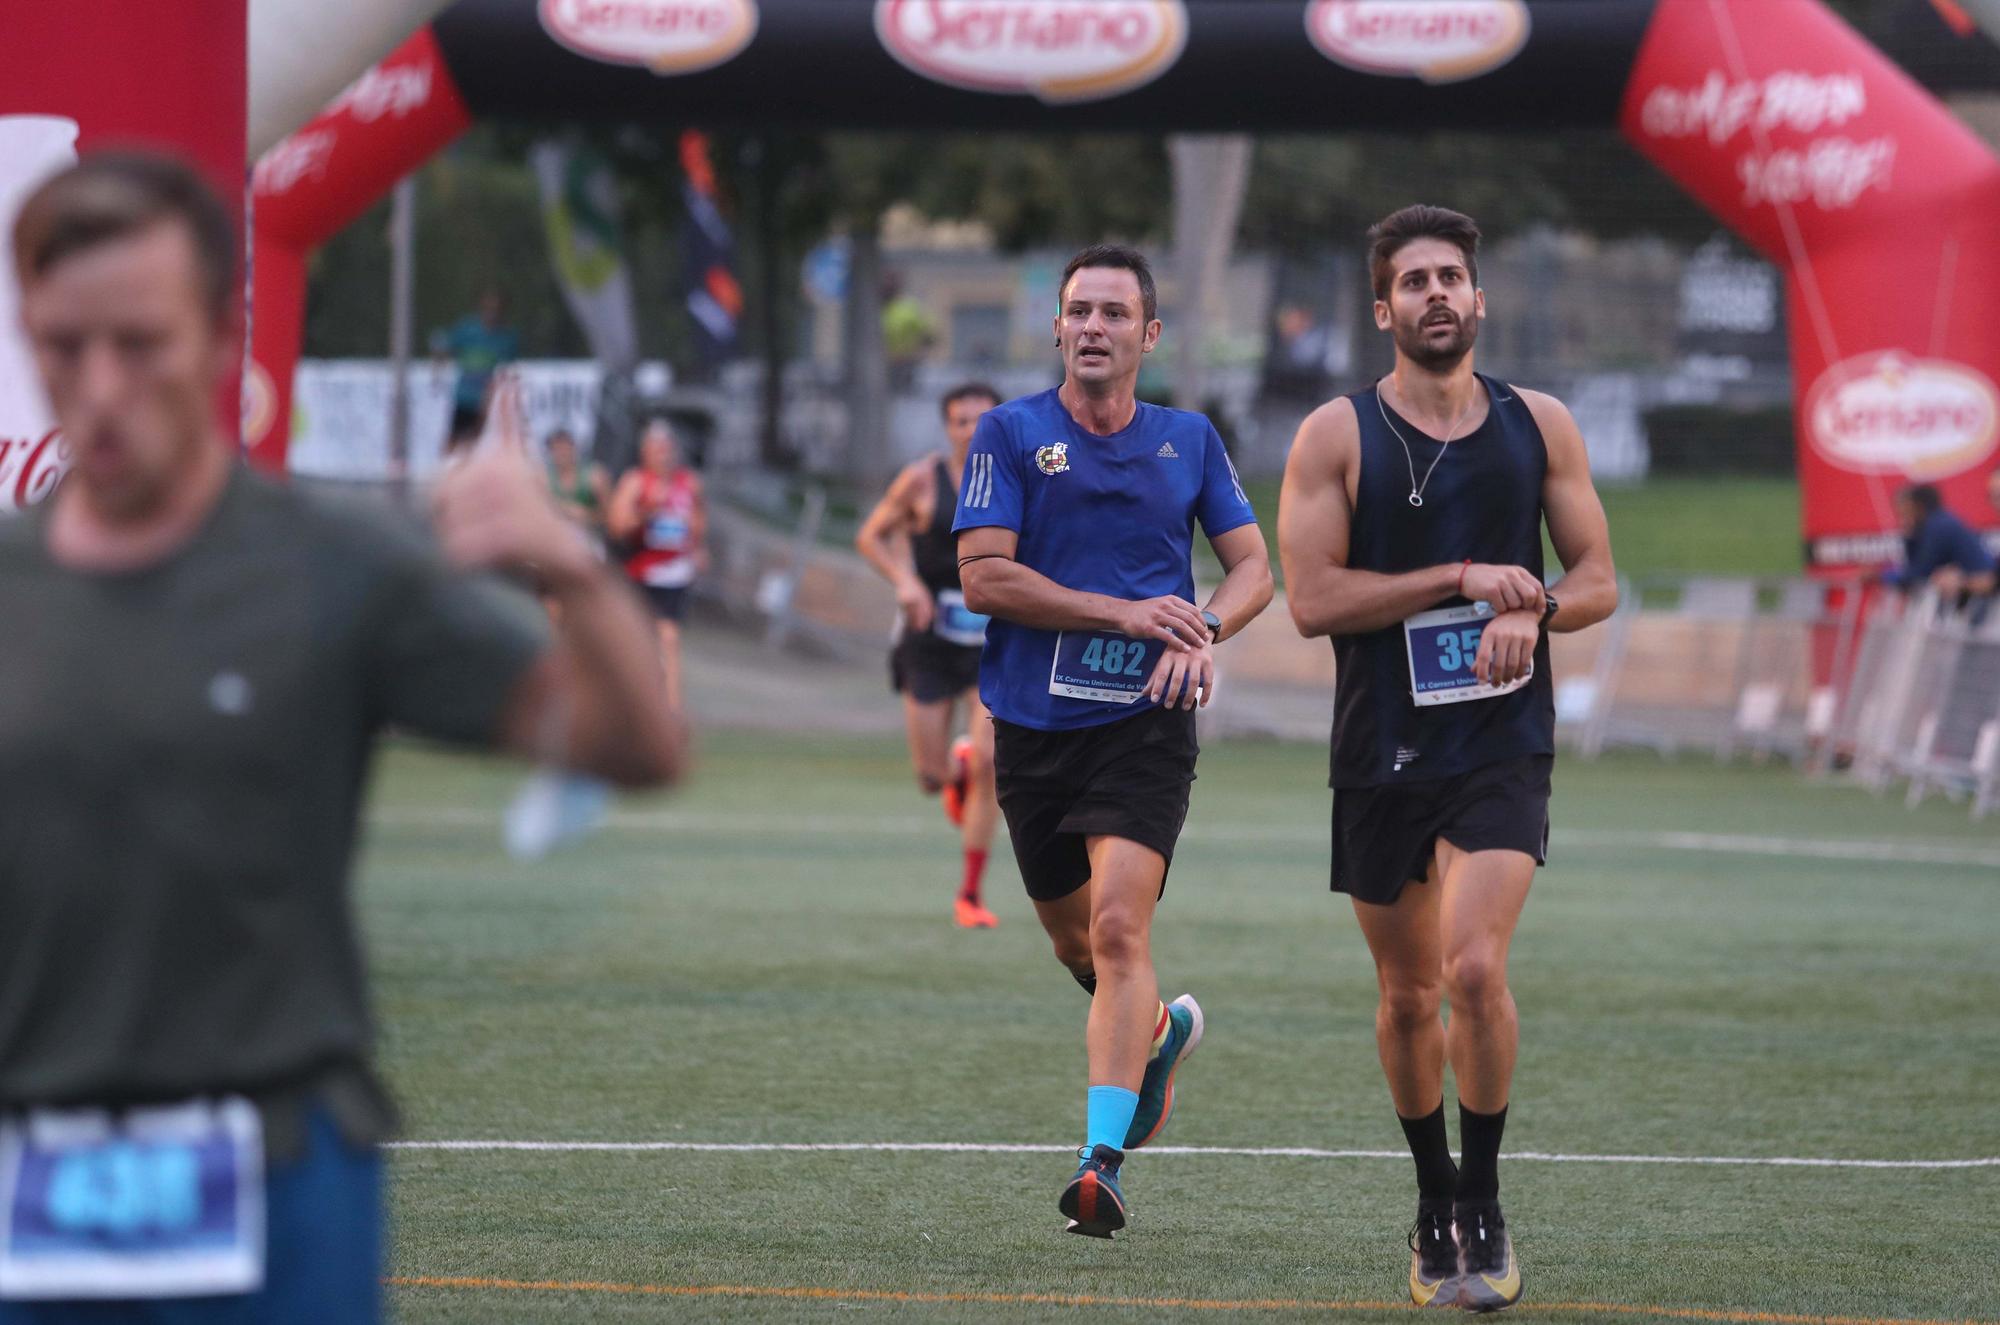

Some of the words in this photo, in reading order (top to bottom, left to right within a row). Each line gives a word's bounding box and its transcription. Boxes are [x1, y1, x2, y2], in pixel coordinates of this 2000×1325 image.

[1157, 450, 1178, 458] adidas
[1081, 637, 1146, 677] 482
[1436, 628, 1482, 672] 35
[1065, 675, 1090, 685] Carrera
[1126, 682, 1135, 690] de
